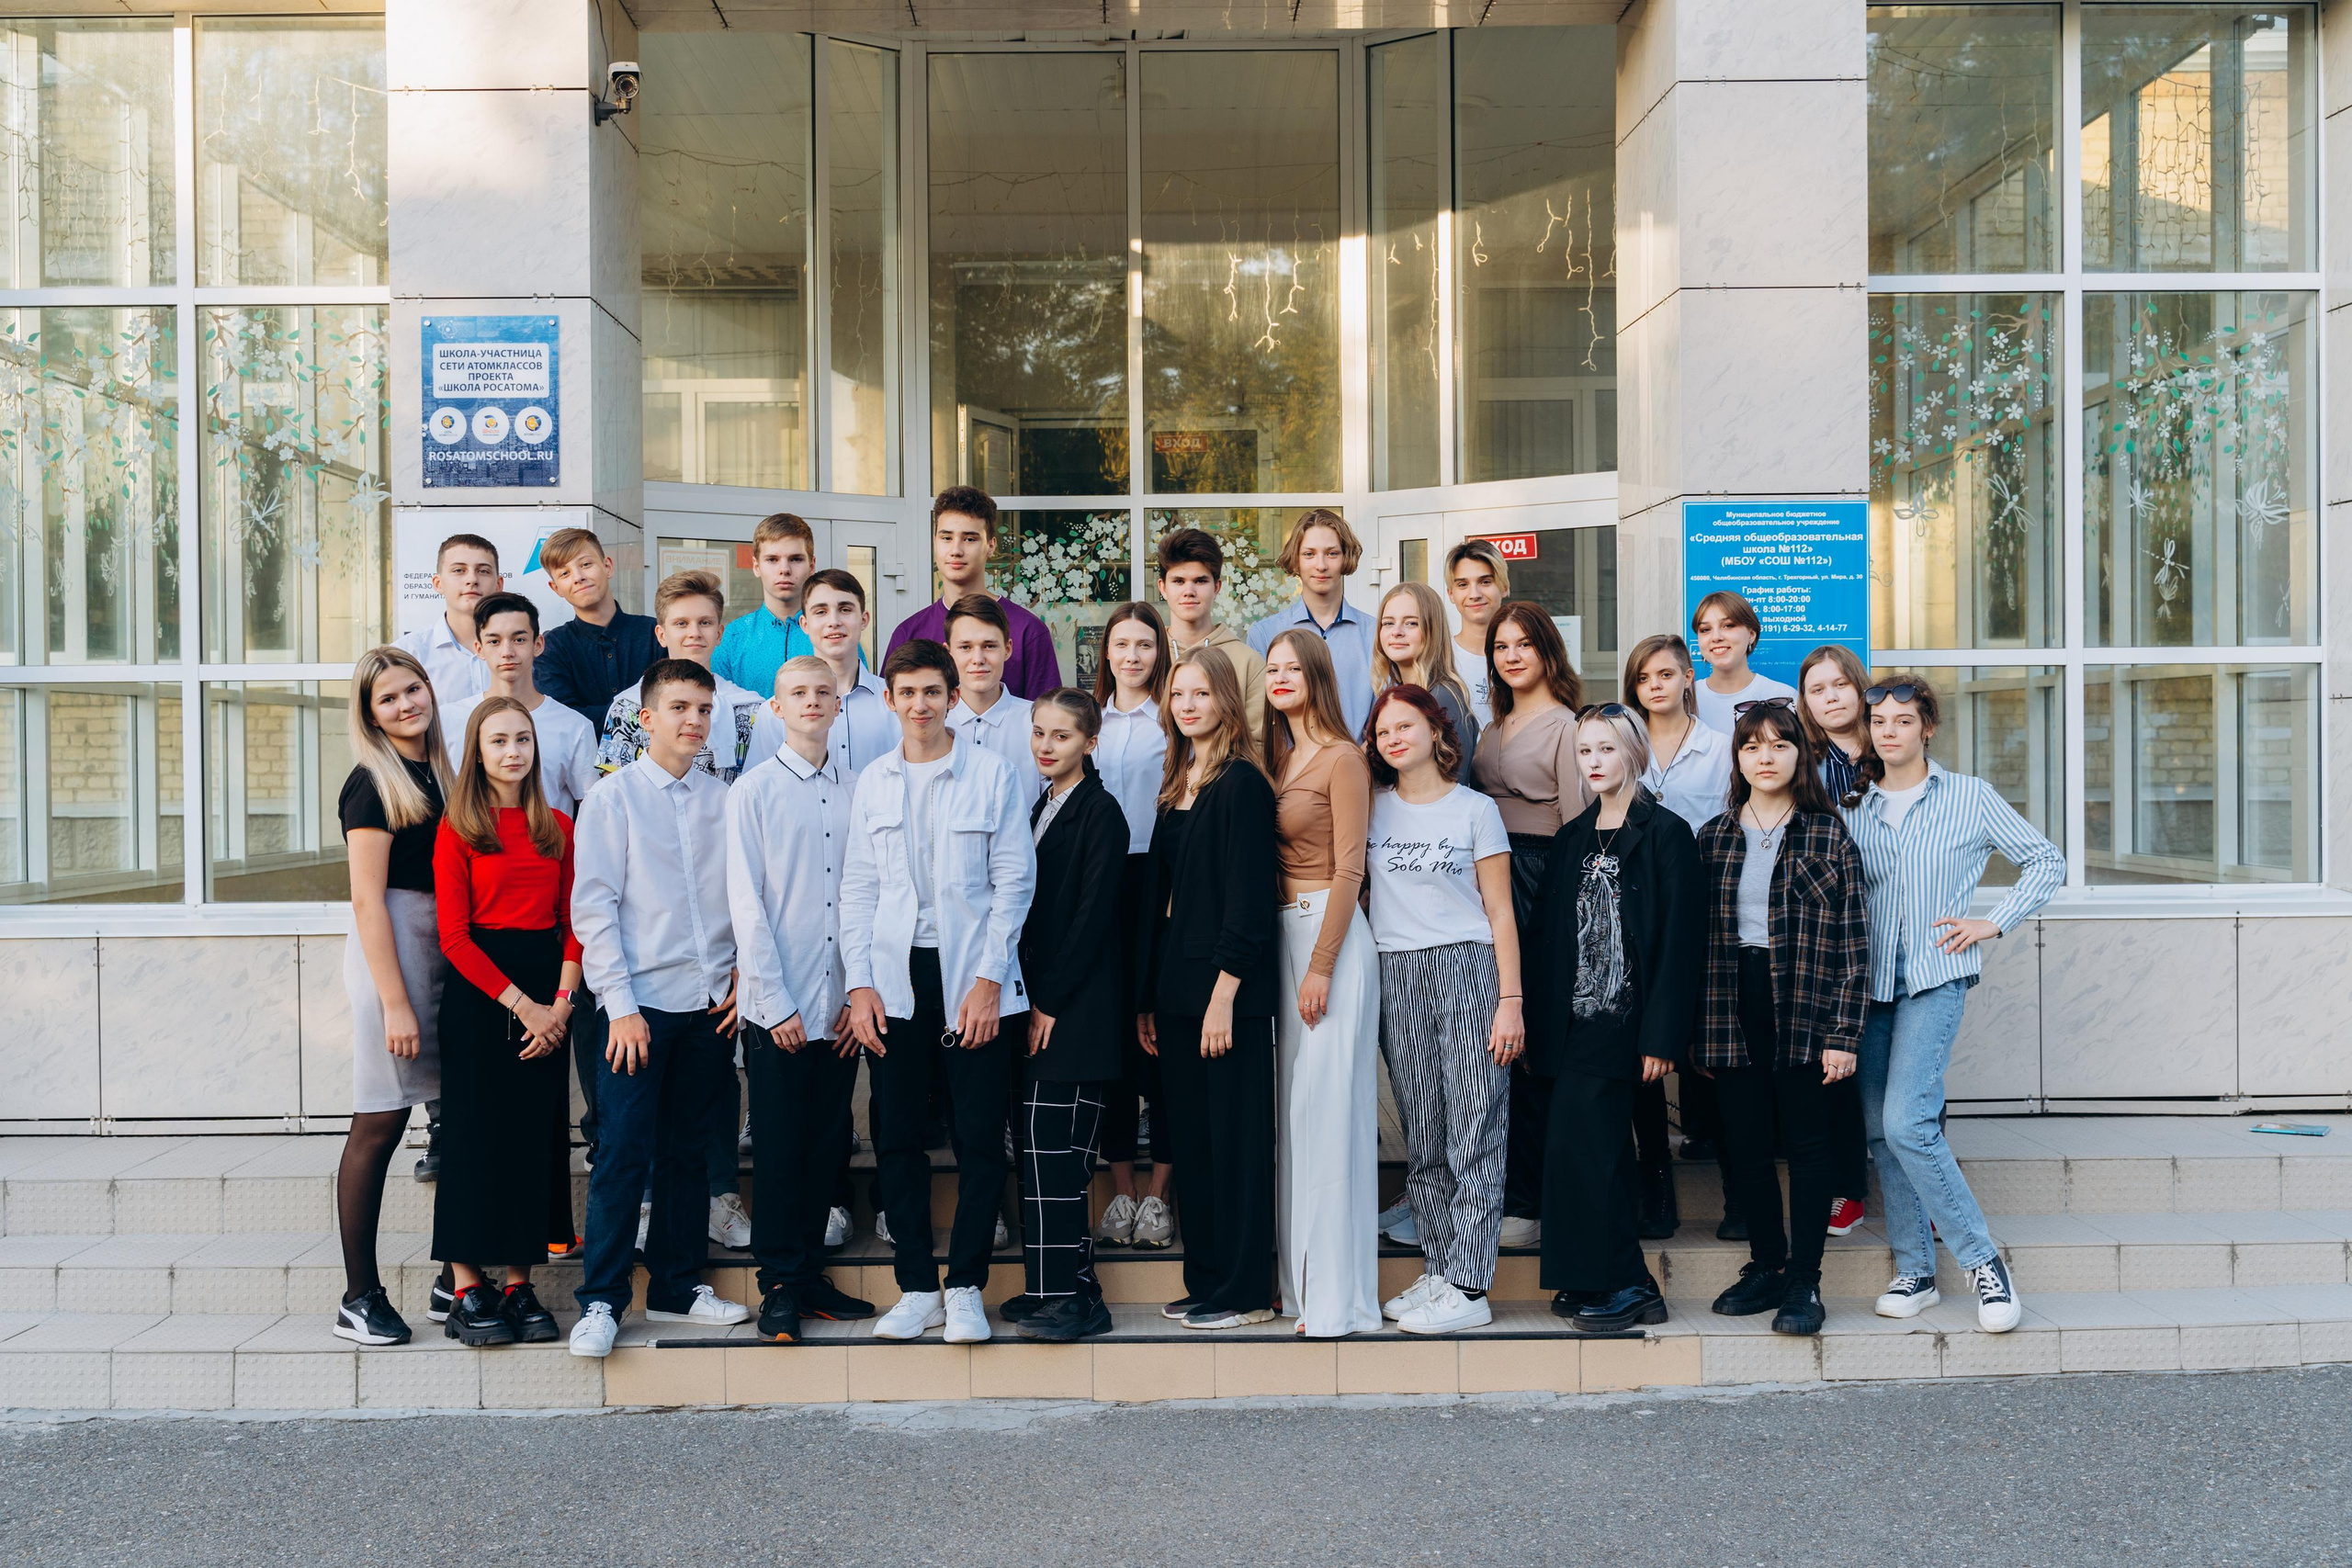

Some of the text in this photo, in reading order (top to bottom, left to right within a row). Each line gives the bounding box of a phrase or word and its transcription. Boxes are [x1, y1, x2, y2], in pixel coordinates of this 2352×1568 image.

[439, 349, 542, 359] ШКОЛА-УЧАСТНИЦА
[439, 361, 543, 370] СЕТИ АТОМКЛАССОВ
[468, 373, 514, 381] ПРОЕКТА
[438, 383, 545, 393] «ШКОЛА РОСАТОМА»
[1163, 438, 1201, 449] ВХОД
[429, 450, 553, 461] ROSATOMSCHOOL.RU
[1725, 511, 1784, 519] Муниципальное
[1690, 533, 1863, 544] «Средняя общеобразовательная
[1490, 539, 1527, 556] ХОД
[1779, 545, 1814, 553] №112»
[1721, 556, 1832, 567] (МБОУ «СОШ №112»)
[1742, 585, 1812, 594] График работы:
[1768, 595, 1811, 604] 8:00-20:00
[1762, 615, 1807, 623] выходной
[1782, 624, 1815, 633] 6-29-32,
[1817, 624, 1848, 632] 4-14-77
[1381, 836, 1431, 858] happy
[1438, 837, 1455, 859] by
[1387, 856, 1422, 873] Solo
